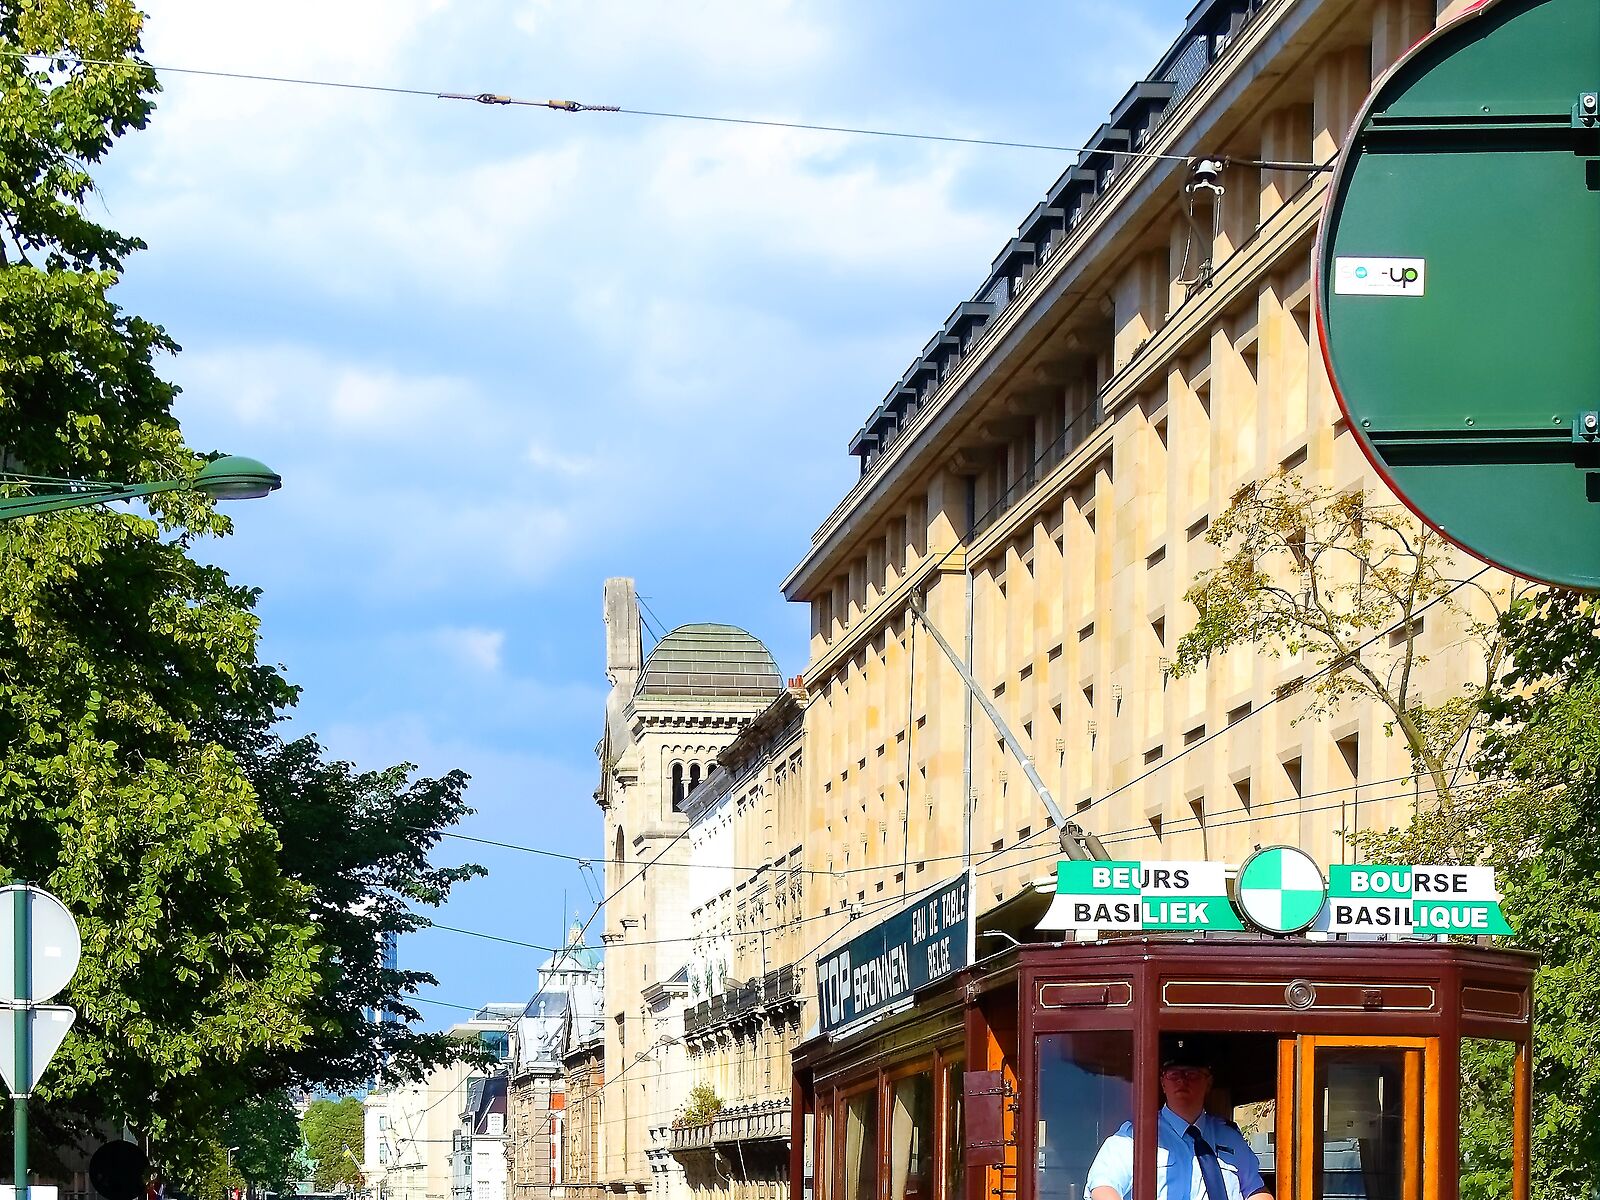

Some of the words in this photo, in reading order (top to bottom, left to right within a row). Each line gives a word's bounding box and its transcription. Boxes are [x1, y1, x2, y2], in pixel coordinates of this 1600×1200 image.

[1092, 867, 1190, 889] BEURS
[1350, 871, 1468, 893] BOURSE
[912, 908, 927, 946] EAU
[928, 899, 939, 937] DE
[941, 883, 966, 930] TABLE
[1074, 902, 1210, 924] BASILIEK
[1336, 905, 1489, 929] BASILIQUE
[927, 936, 951, 980] BELGE
[818, 950, 851, 1029] TOP
[853, 942, 910, 1014] BRONNEN
